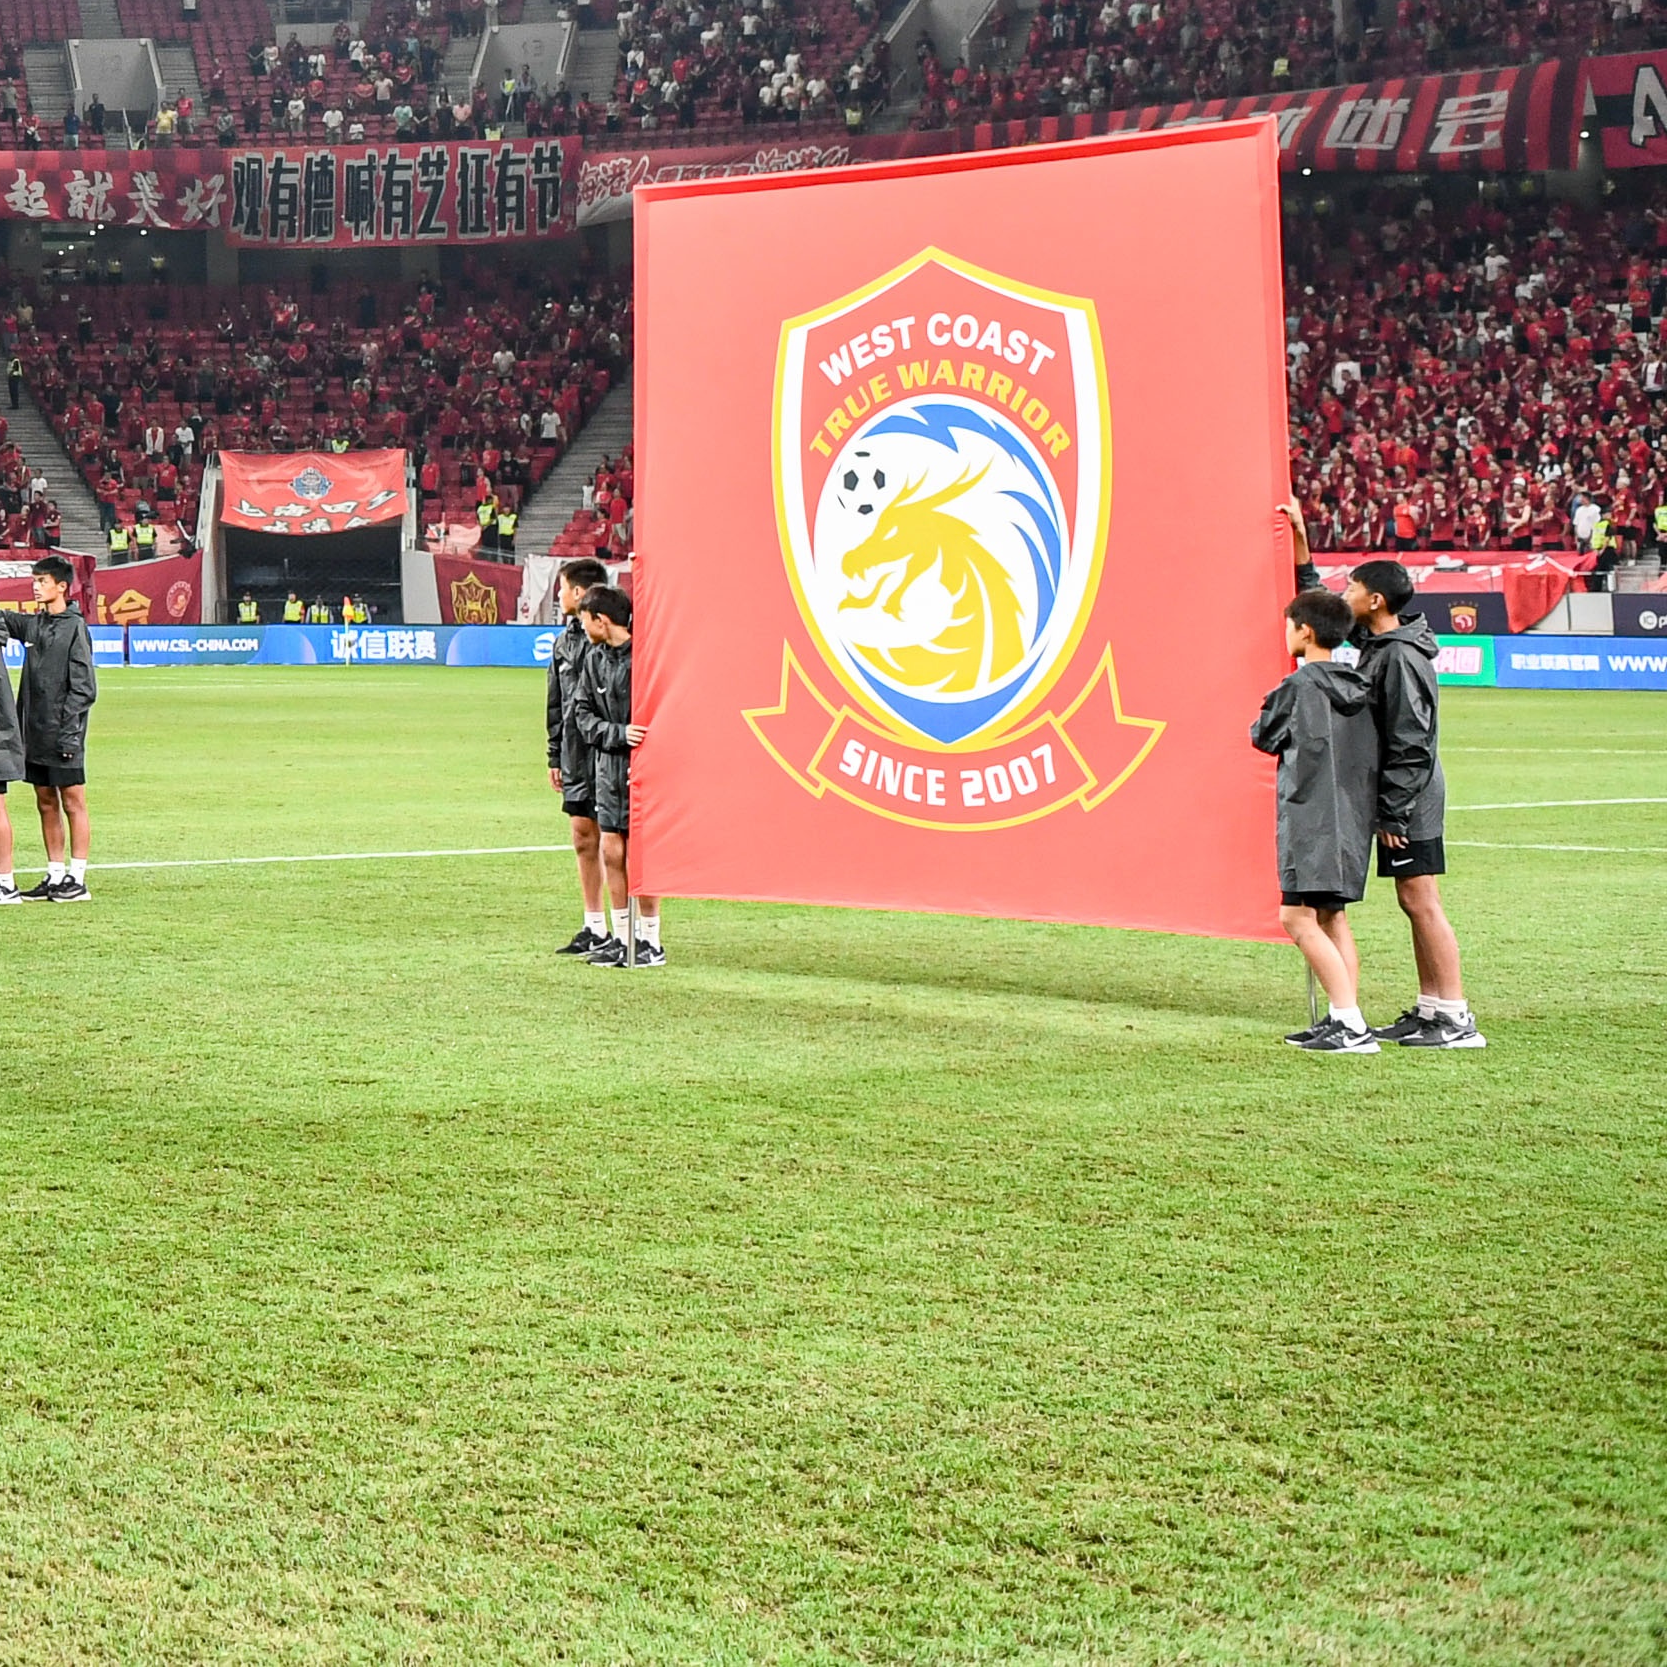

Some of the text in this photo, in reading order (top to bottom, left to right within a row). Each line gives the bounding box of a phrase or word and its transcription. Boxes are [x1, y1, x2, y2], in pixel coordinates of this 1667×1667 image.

[818, 312, 1056, 386] WEST COAST
[809, 359, 1071, 459] TRUE WARRIOR
[132, 638, 259, 652] WWW.CSL-CHINA.COM
[331, 630, 437, 660] 诚信联赛
[838, 738, 1057, 807] SINCE 2007
